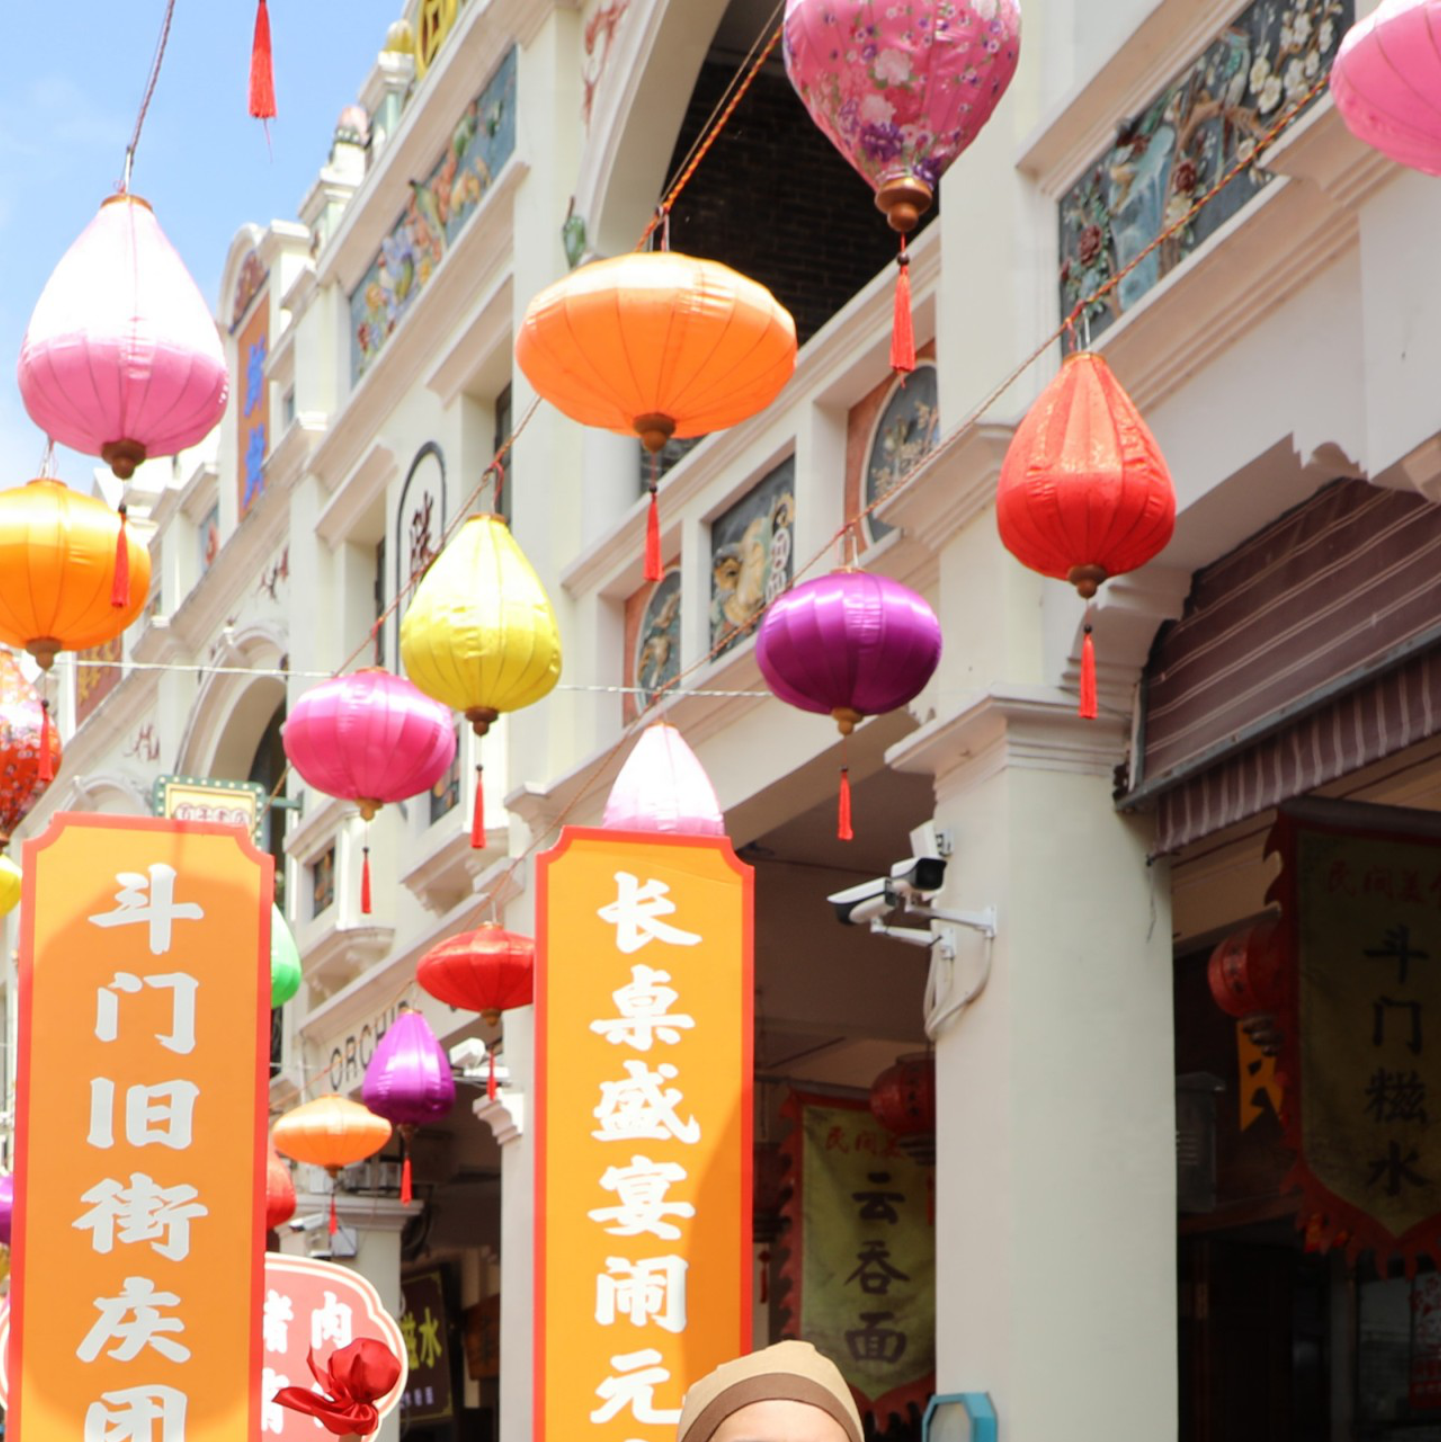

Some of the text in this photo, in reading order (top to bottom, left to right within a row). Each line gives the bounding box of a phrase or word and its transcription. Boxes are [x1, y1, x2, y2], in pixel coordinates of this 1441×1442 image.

[1363, 923, 1431, 1198] 斗门糍水
[843, 1170, 910, 1364] 云吞面
